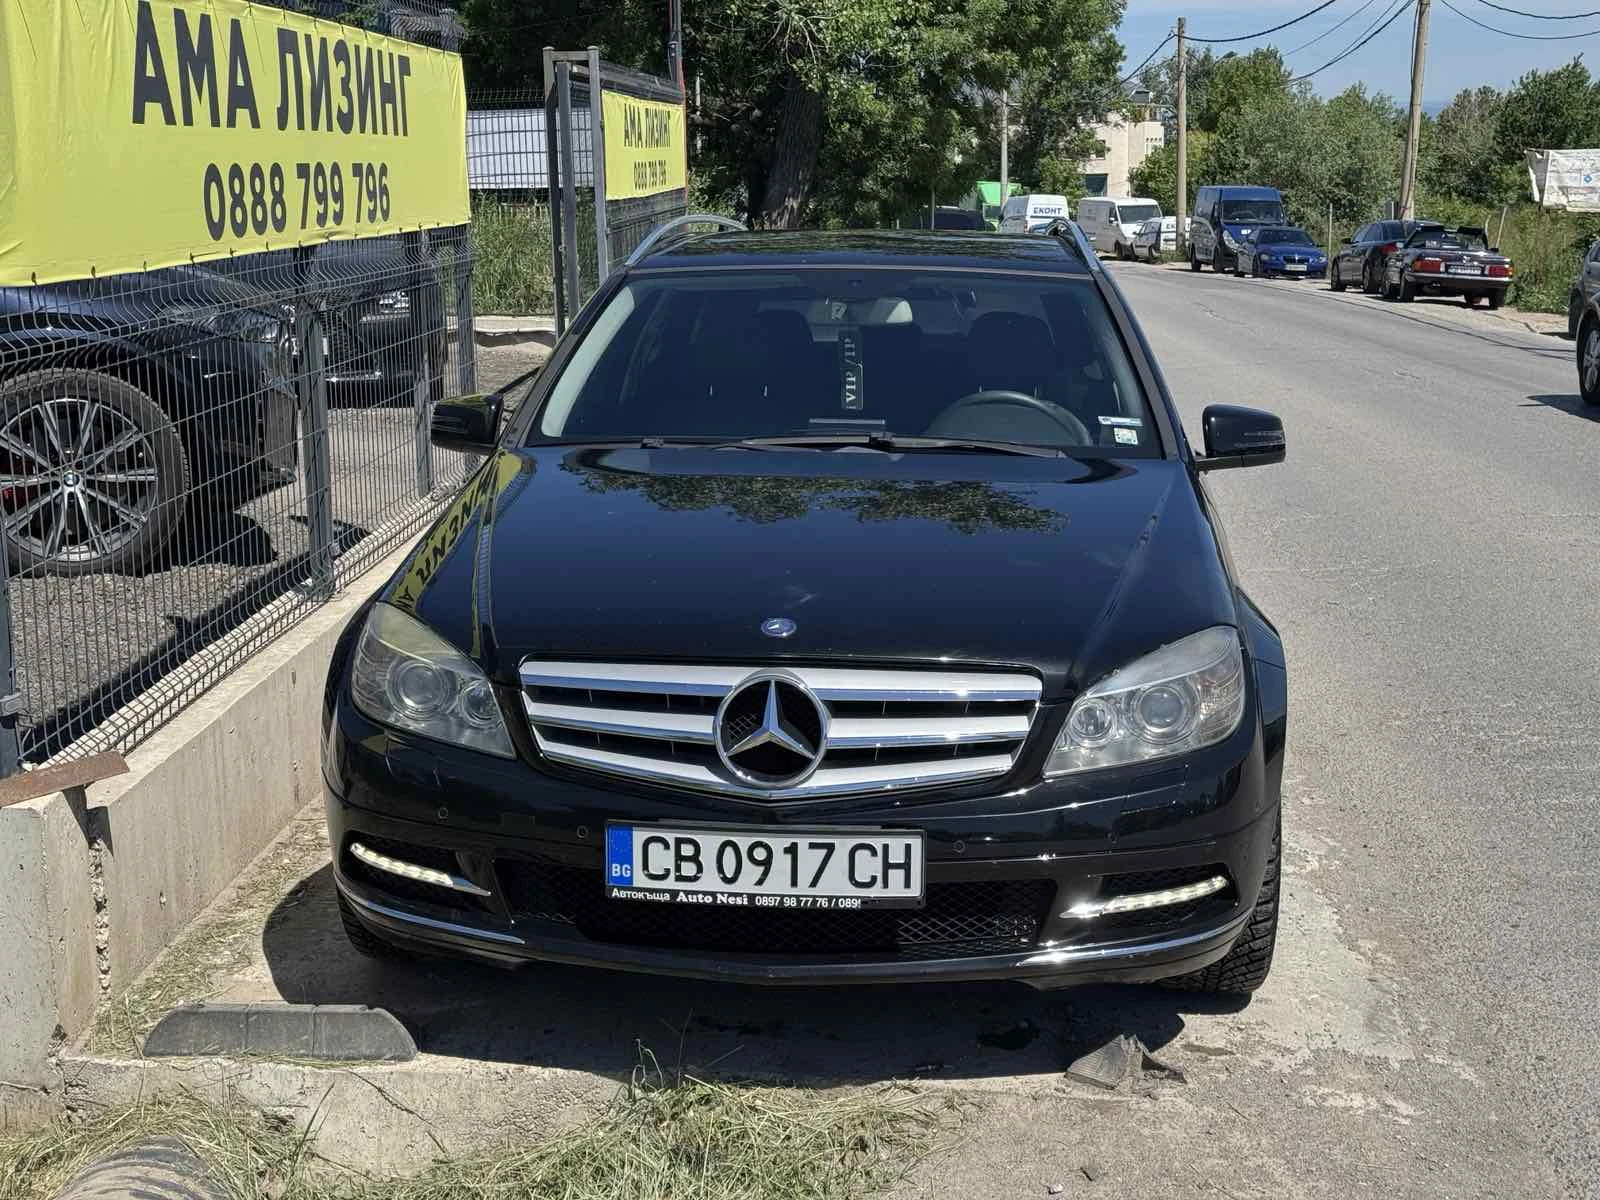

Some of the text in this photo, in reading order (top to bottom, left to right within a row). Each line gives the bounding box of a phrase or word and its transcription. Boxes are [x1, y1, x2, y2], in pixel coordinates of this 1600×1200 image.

[133, 0, 410, 136] АМА ЛИЗИНГ
[624, 103, 643, 148] АМА
[204, 162, 390, 241] 0888 799 796
[611, 864, 631, 877] BG
[642, 836, 911, 888] CB 0917 CH
[611, 888, 670, 902] Автокъща
[676, 891, 713, 903] Auto
[716, 893, 748, 905] Nesi
[755, 896, 780, 906] 0897
[783, 897, 797, 907] 98
[800, 898, 813, 907] 77
[816, 898, 829, 908] 76
